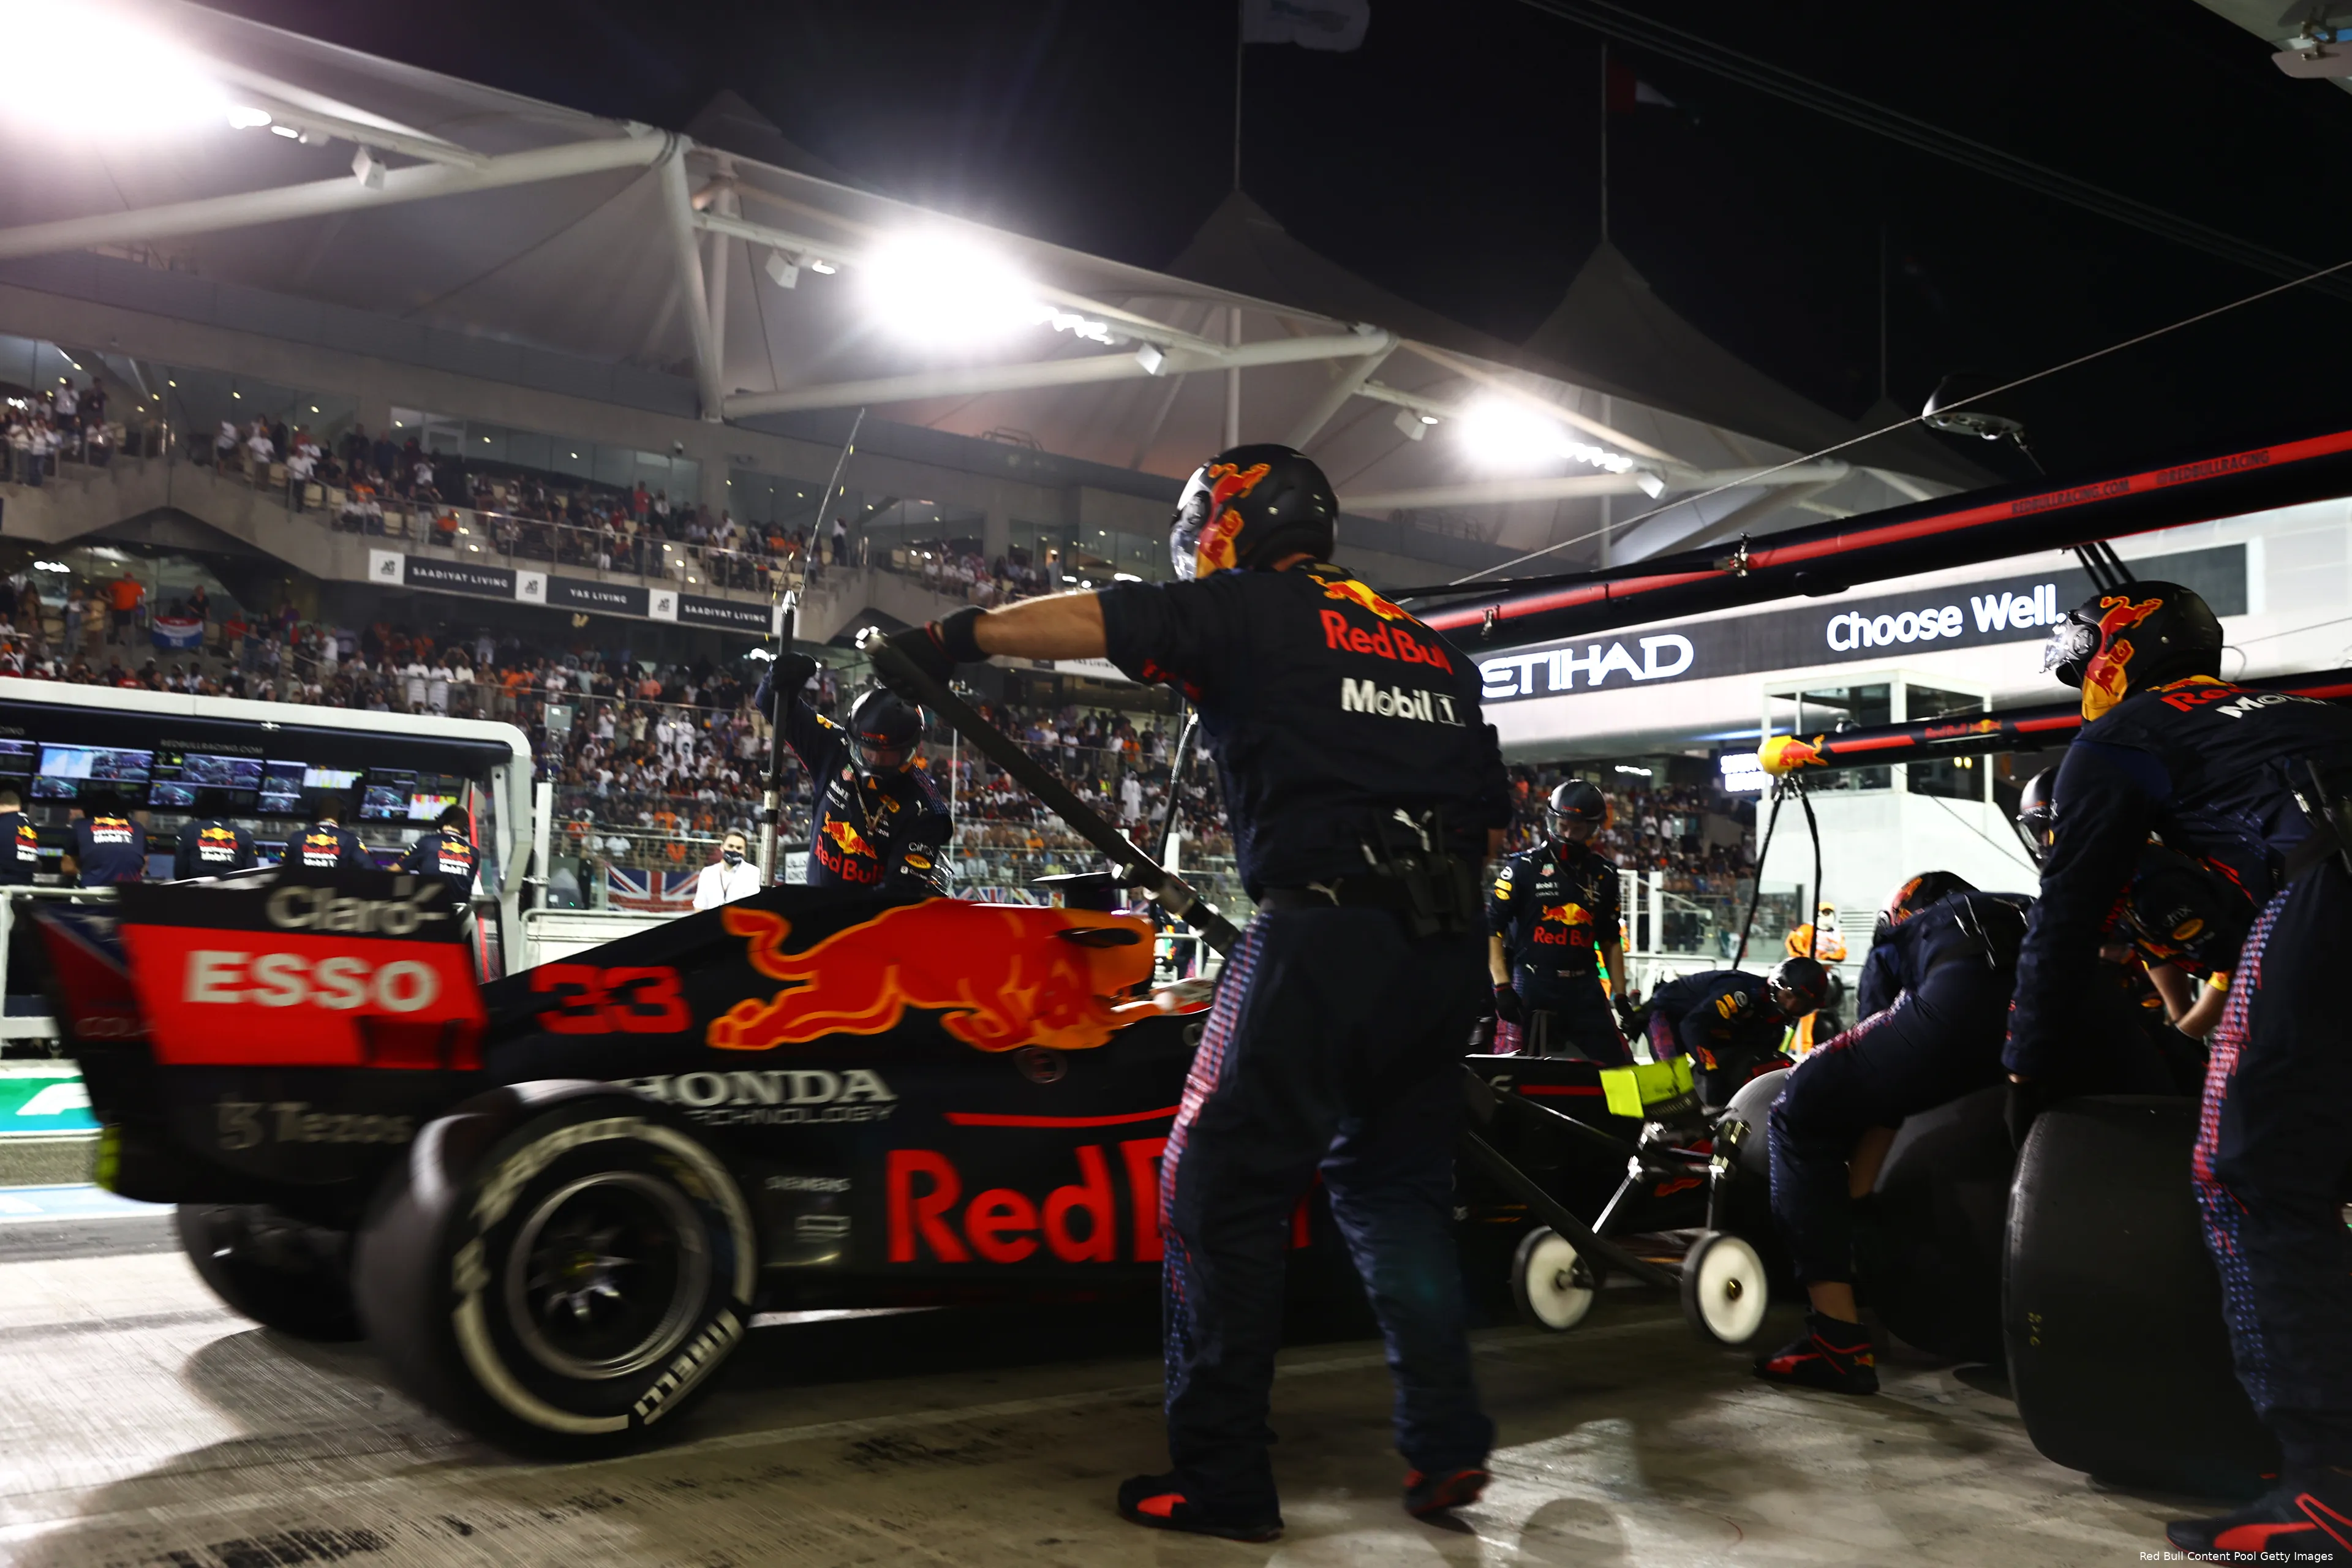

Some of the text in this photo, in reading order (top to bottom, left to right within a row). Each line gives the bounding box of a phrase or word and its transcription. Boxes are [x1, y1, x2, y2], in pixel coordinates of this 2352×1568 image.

[471, 575, 508, 589] LIVING
[570, 588, 628, 605] YAS LIVING
[734, 611, 767, 624] LIVING
[1319, 609, 1397, 660] Red
[1826, 584, 2067, 652] Choose Well.
[1478, 635, 1695, 699] ETIHAD
[1341, 677, 1435, 723] Mobil
[815, 834, 842, 874] Red
[842, 858, 886, 884] Bull
[266, 882, 432, 935] Claro
[1533, 925, 1595, 948] Red Bu
[186, 949, 440, 1012] ESSO
[531, 963, 693, 1035] 33
[619, 1068, 899, 1107] HONDA
[886, 1144, 1116, 1264] Red
